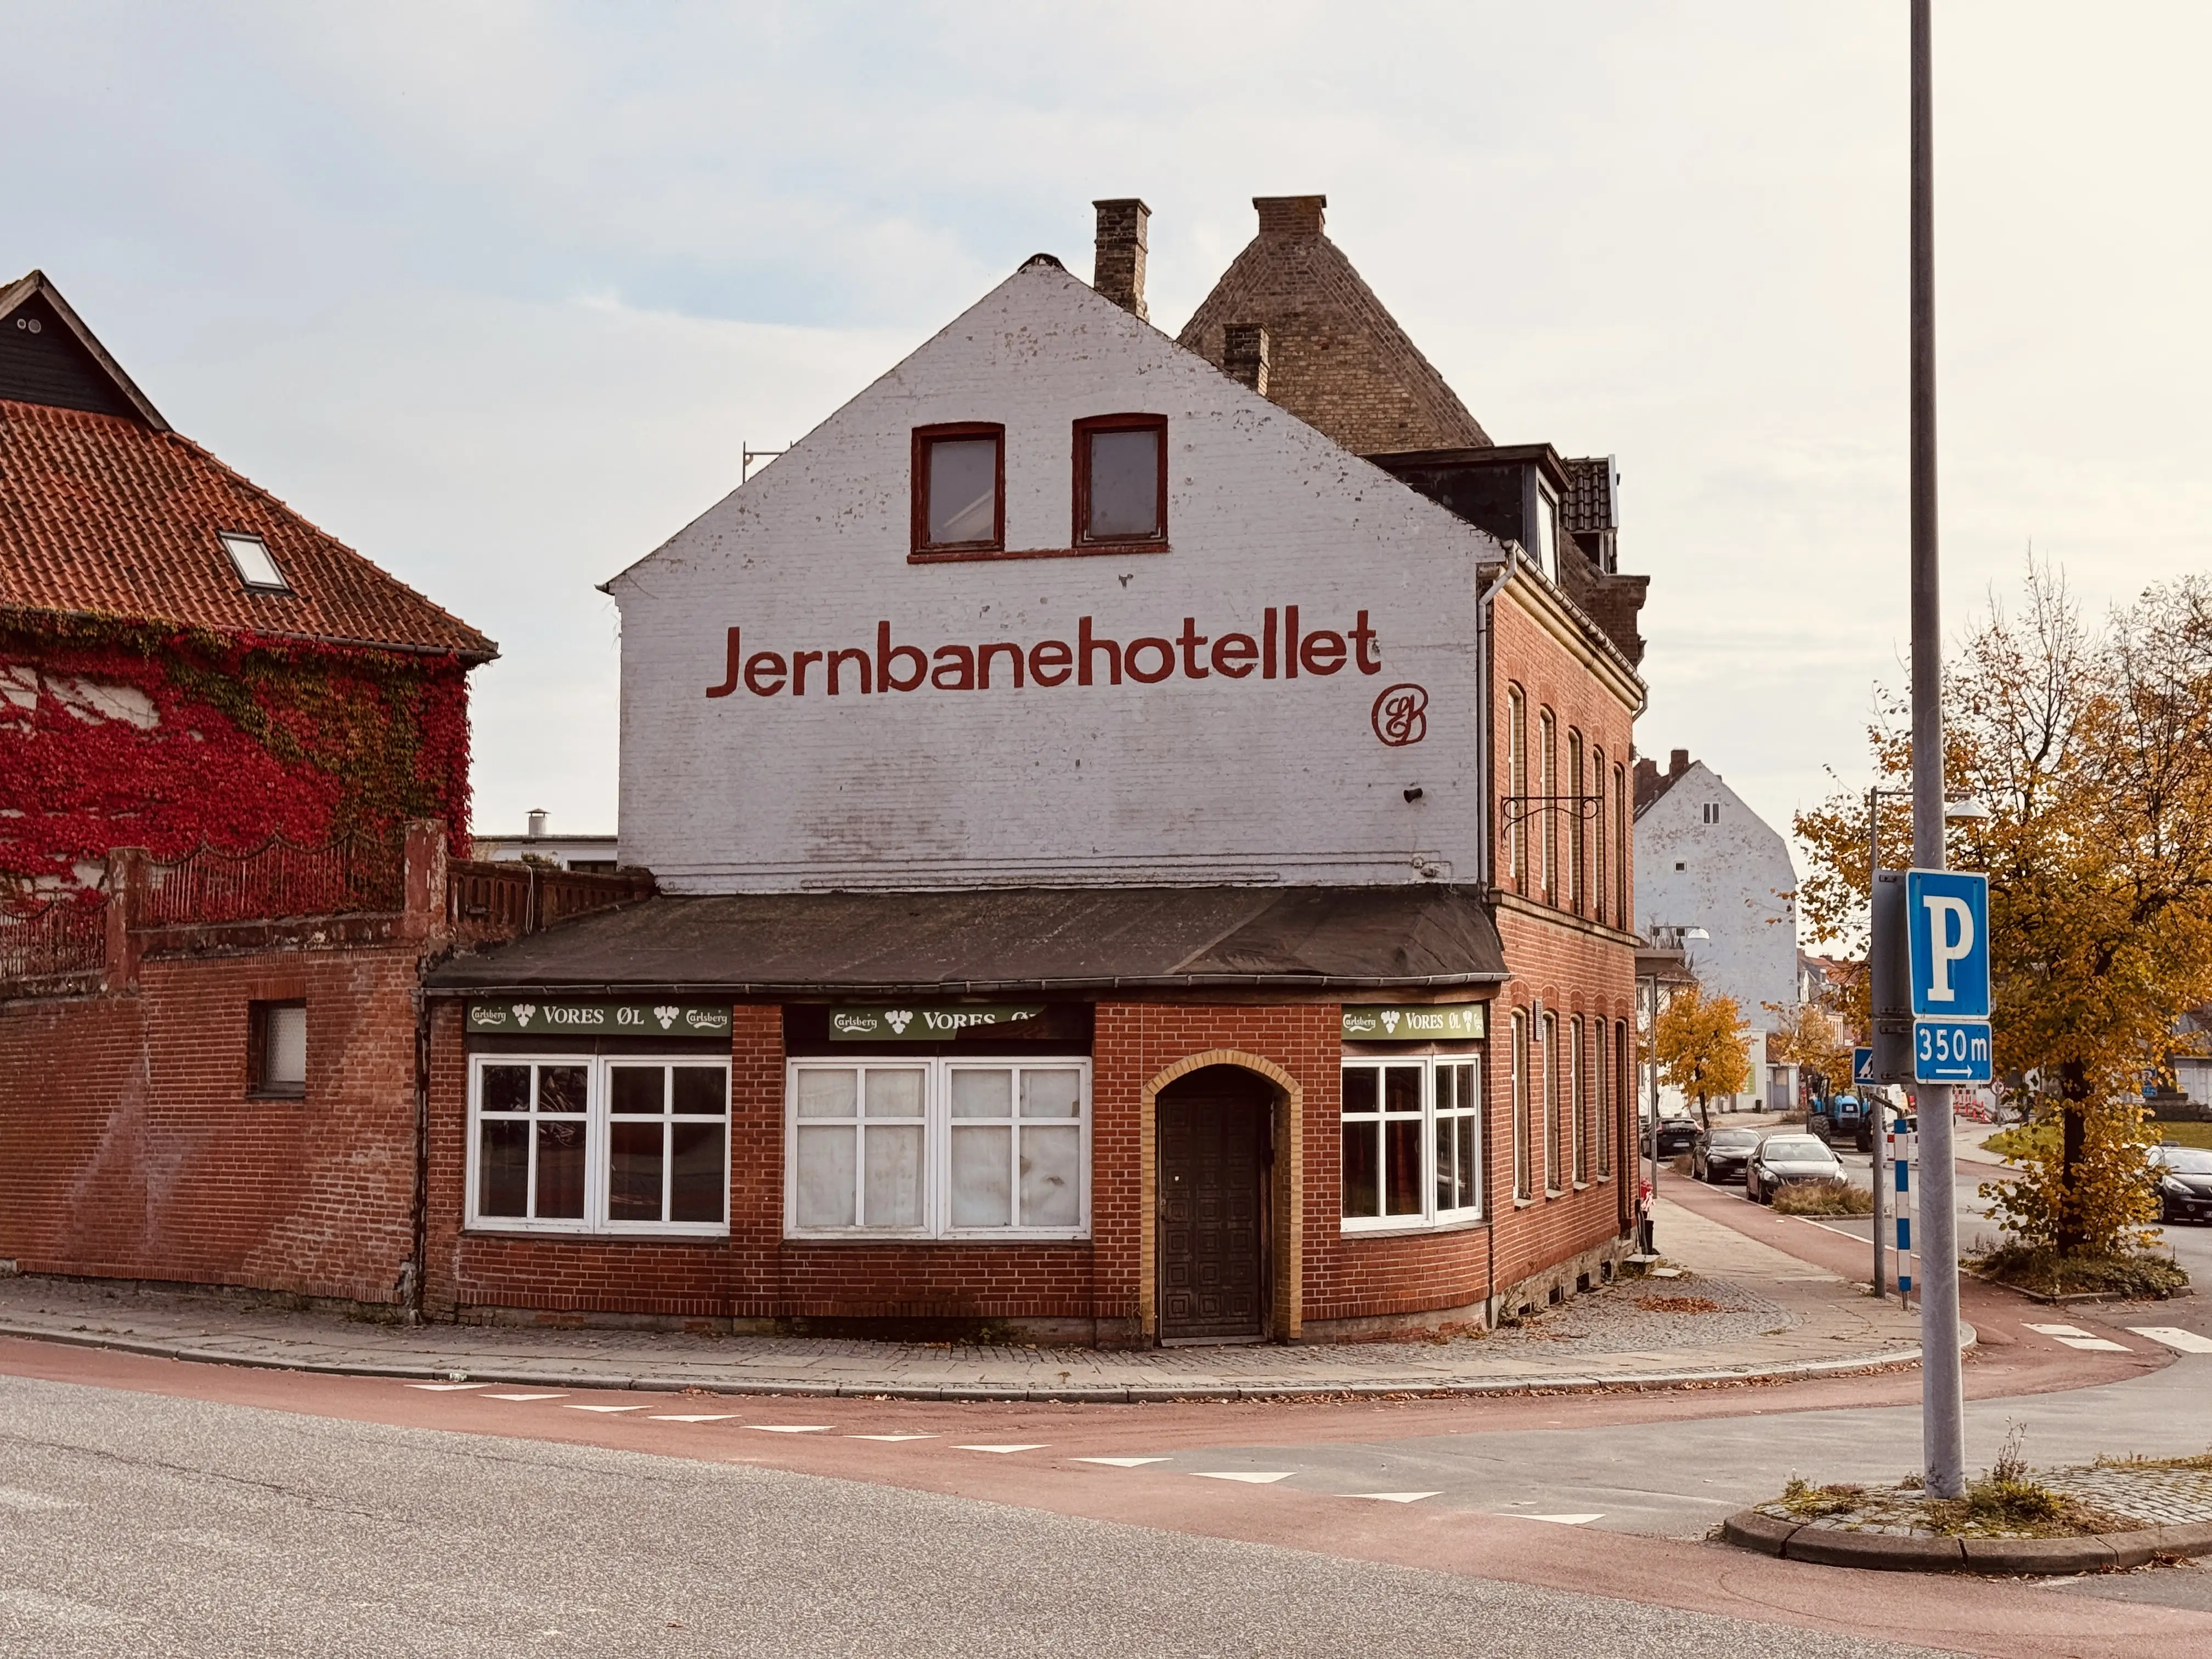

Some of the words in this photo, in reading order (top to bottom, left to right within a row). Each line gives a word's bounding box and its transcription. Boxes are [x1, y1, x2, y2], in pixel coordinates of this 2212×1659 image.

[706, 606, 1380, 698] Jernbanehotellet
[1923, 895, 1974, 1002] P
[471, 1006, 506, 1025] Carlsberg
[543, 1006, 604, 1024] VORES
[617, 1006, 645, 1025] ØL
[686, 1009, 727, 1029] Carlsberg
[834, 1013, 878, 1032] Carlsberg
[1342, 1013, 1376, 1032] Carlsberg
[1406, 1012, 1444, 1030] VORES
[1448, 1011, 1462, 1030] ØL
[1919, 1028, 1967, 1062] 350
[1971, 1037, 1988, 1062] m
